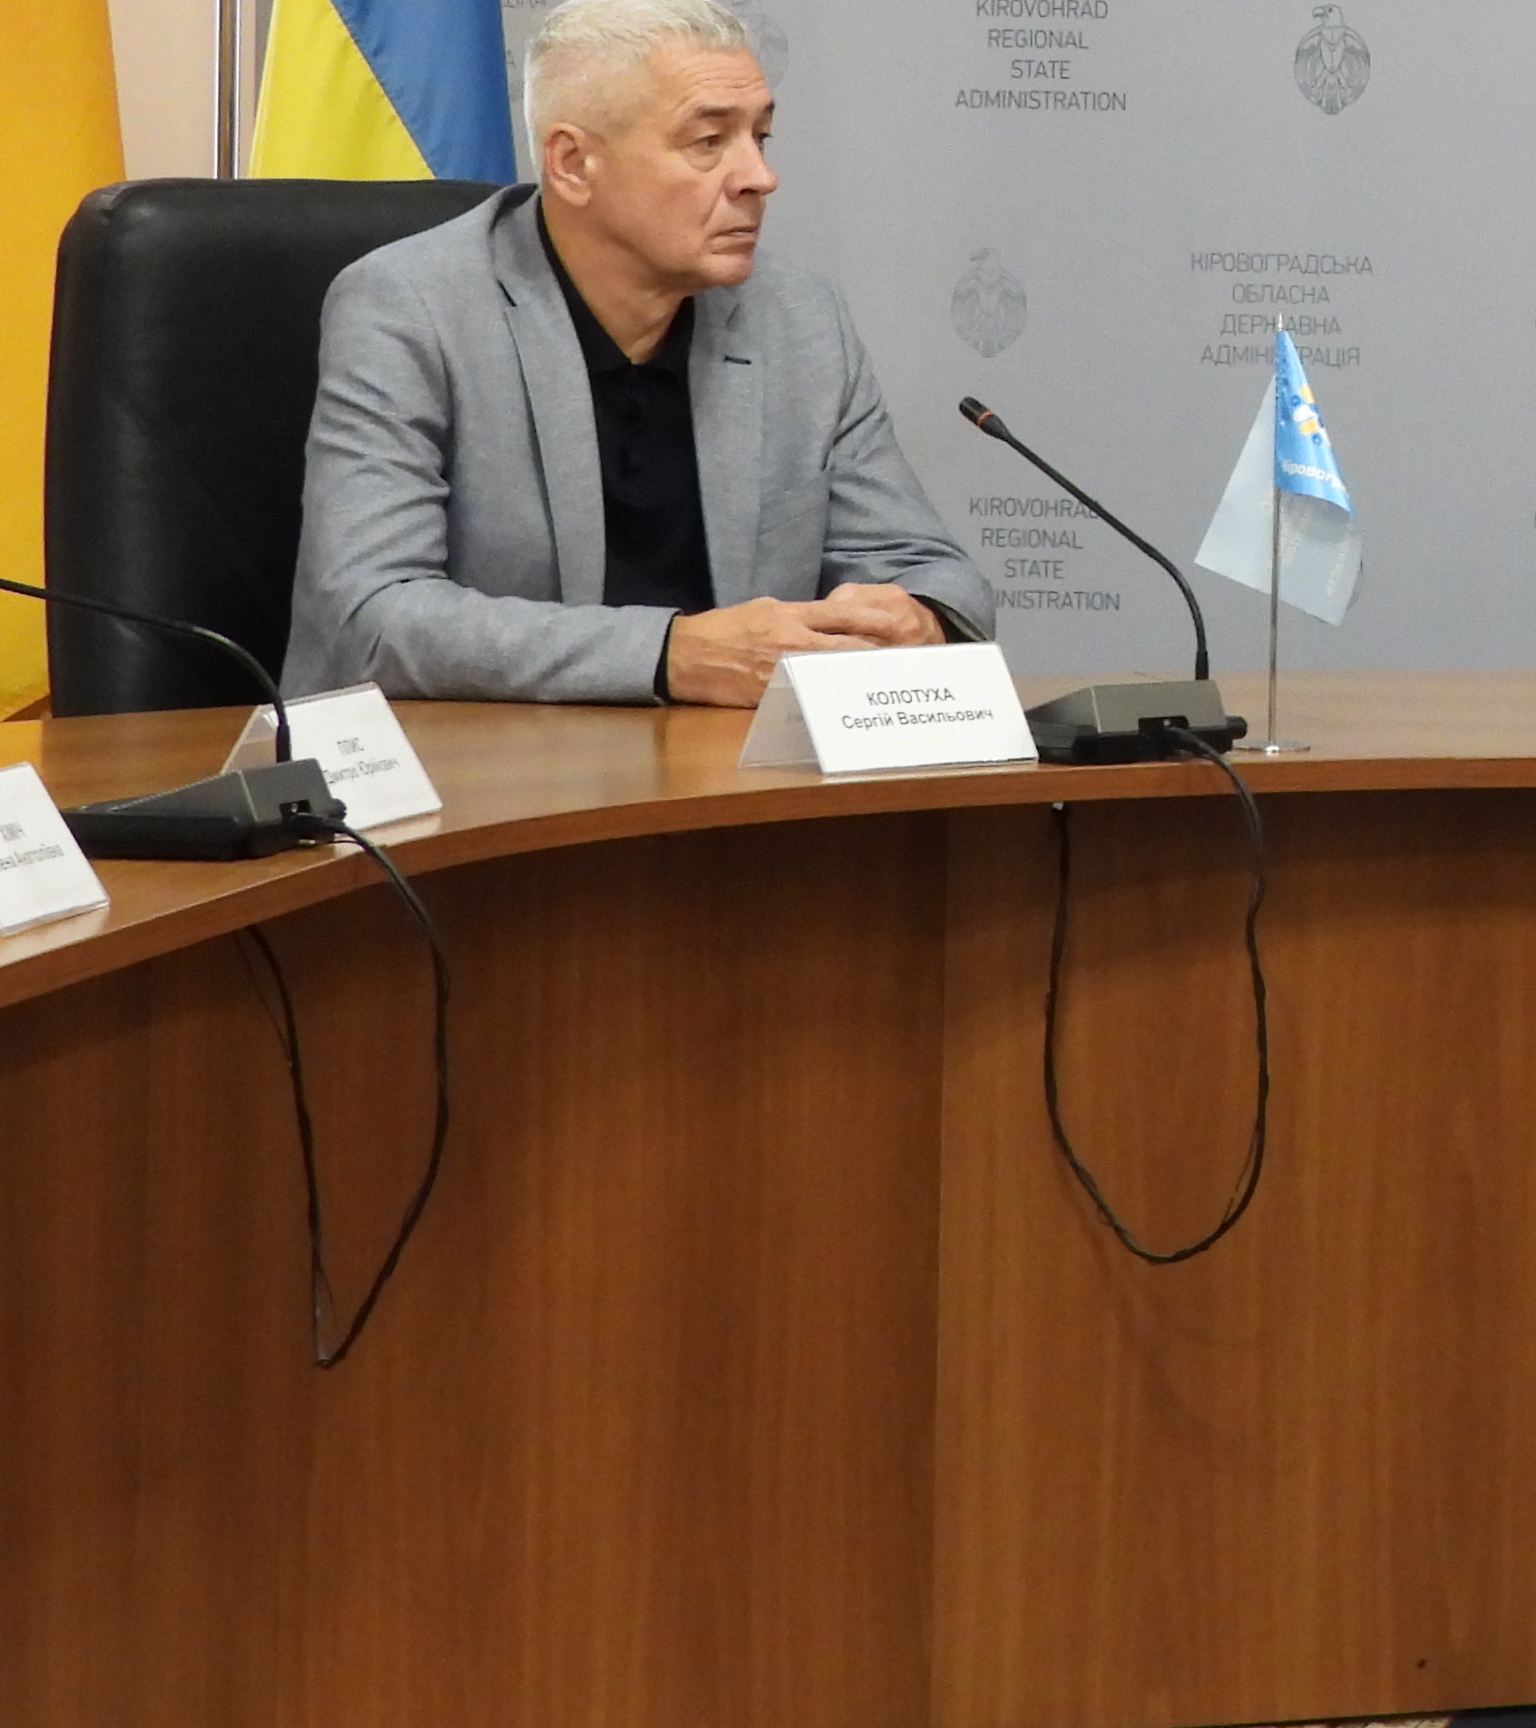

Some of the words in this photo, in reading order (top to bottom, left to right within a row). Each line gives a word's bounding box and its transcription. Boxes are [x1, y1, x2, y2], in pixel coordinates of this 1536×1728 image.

[987, 27, 1090, 50] REGIONAL
[1010, 58, 1071, 81] STATE
[954, 88, 1127, 112] ADMINISTRATION
[1190, 251, 1373, 277] КІРОВОГРАДСЬКА
[1232, 283, 1330, 305] ОБЛАСНА
[981, 528, 1083, 550] REGIONAL
[1004, 559, 1065, 580] STATE
[996, 590, 1121, 611] INISTRATION
[867, 687, 955, 707] КОЛОТУХА
[842, 713, 893, 732] Сергій
[898, 708, 994, 726] Васильович
